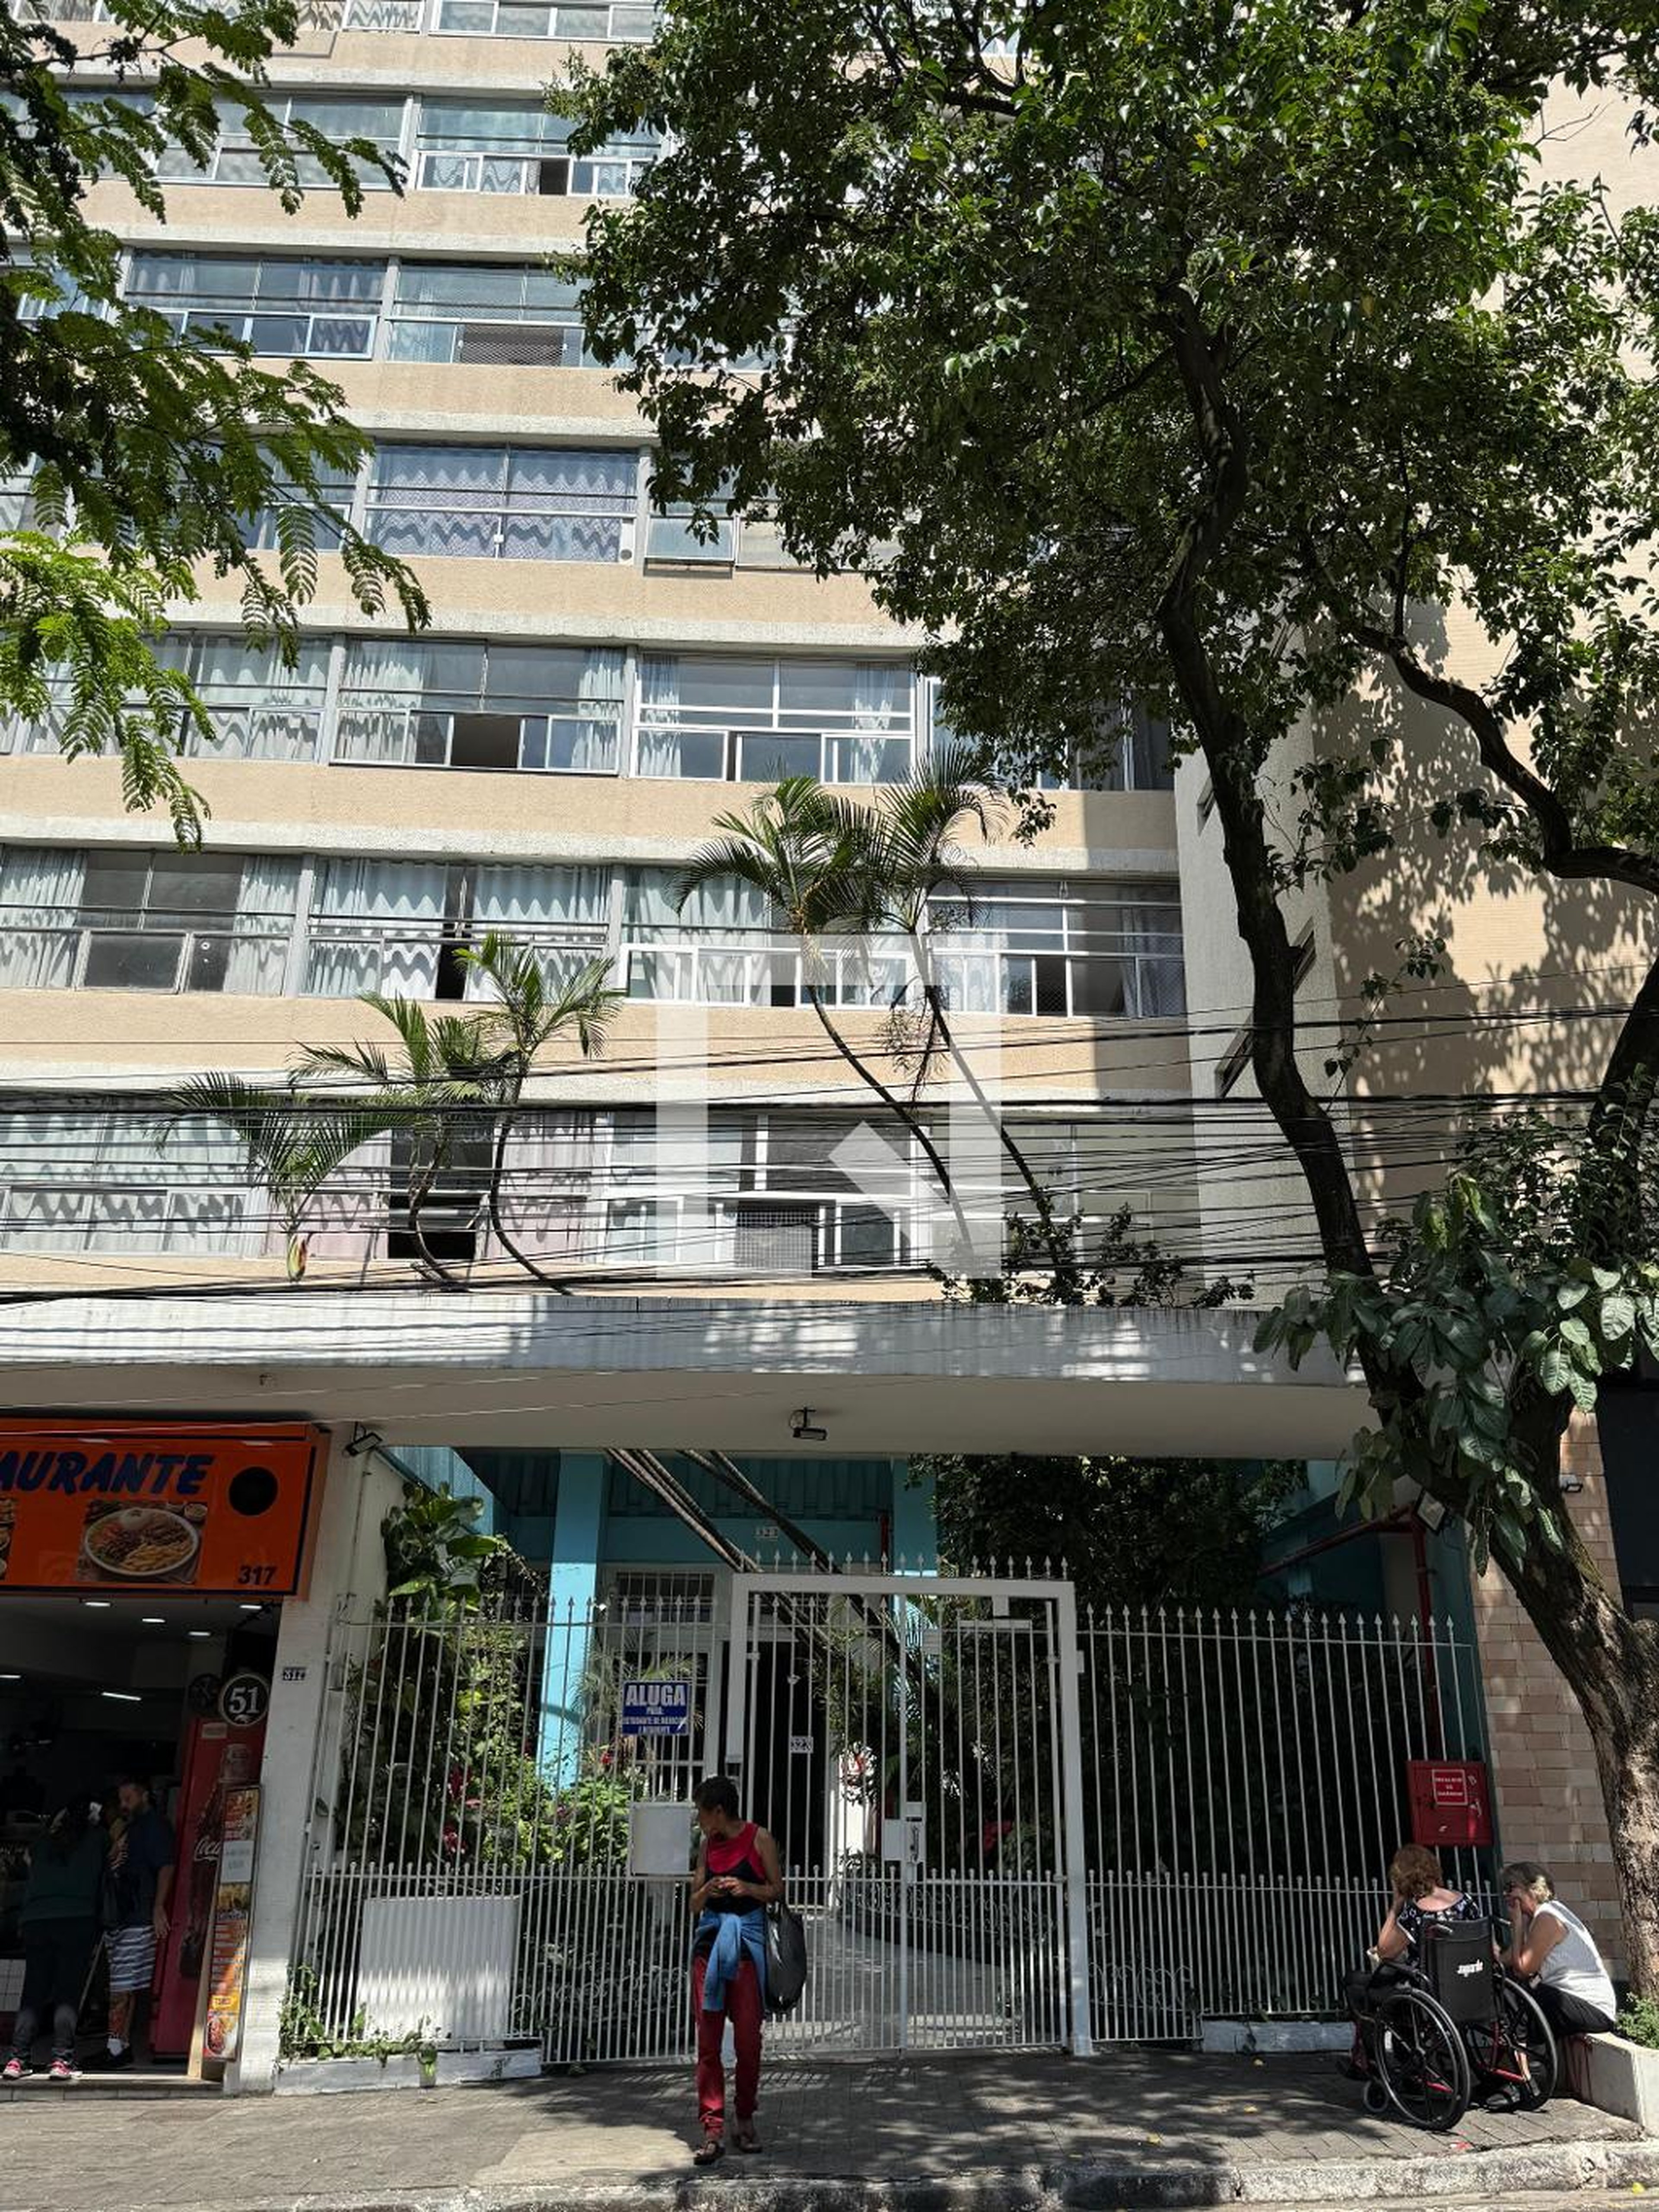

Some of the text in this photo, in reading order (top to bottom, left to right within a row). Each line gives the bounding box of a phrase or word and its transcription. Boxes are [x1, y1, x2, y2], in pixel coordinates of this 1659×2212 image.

[238, 1565, 276, 1585] 317
[229, 1687, 260, 1714] 51
[625, 1684, 686, 1706] ALUGA
